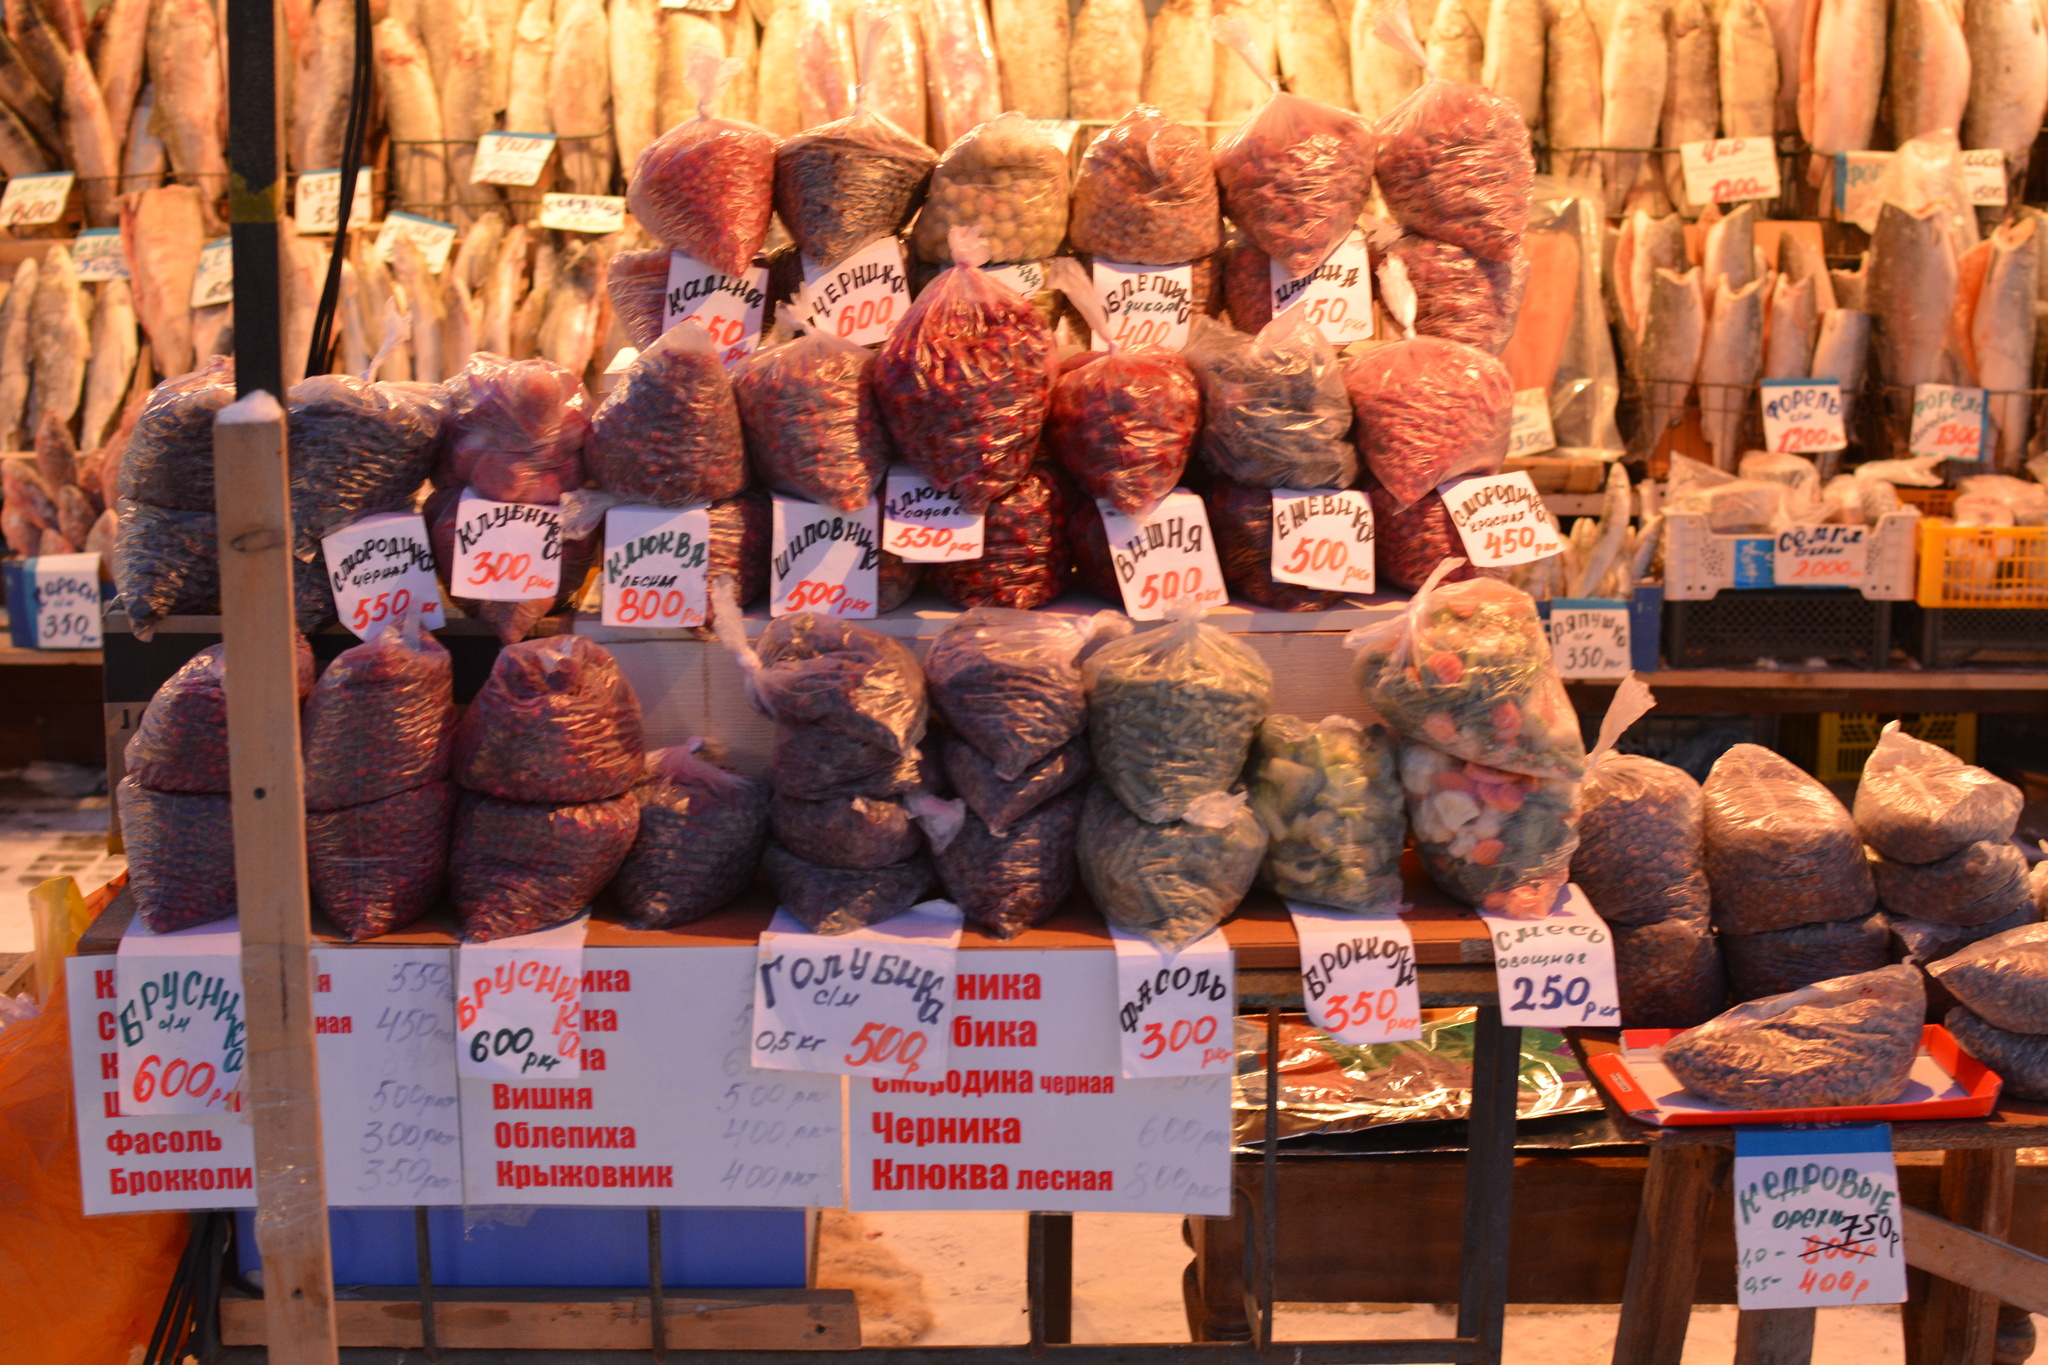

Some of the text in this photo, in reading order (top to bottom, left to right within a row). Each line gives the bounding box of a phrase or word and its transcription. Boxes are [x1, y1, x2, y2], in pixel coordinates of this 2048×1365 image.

[837, 296, 893, 338] 600
[890, 527, 954, 549] 550
[1115, 517, 1203, 585] ВИШНЯ
[1281, 537, 1349, 575] 500
[1483, 526, 1535, 560] 450
[466, 551, 532, 586] 300
[616, 588, 686, 624] 800
[784, 580, 847, 612] 500
[1138, 567, 1203, 609] 500
[42, 613, 88, 639] 350
[352, 588, 411, 630] 550
[1564, 646, 1603, 670] 350
[386, 961, 450, 993] 550
[1510, 974, 1591, 1011] 250
[375, 1006, 439, 1043] 450
[1322, 989, 1398, 1033] 350
[469, 1026, 534, 1063] 600
[755, 1030, 796, 1054] 0,5
[843, 1021, 929, 1067] 500
[1138, 1015, 1218, 1060] 300
[132, 1053, 216, 1104] 600
[368, 1079, 427, 1114] 500
[1040, 1075, 1115, 1096] черная
[493, 1083, 594, 1110] Вишня
[716, 1081, 787, 1114] 500
[107, 1129, 223, 1156] Фасоль
[360, 1120, 422, 1154] 300
[494, 1121, 637, 1149] Облепиха
[722, 1117, 786, 1149] 400
[872, 1112, 1021, 1147] Черника
[1137, 1116, 1200, 1149] 600
[110, 1166, 253, 1196] Брокколи
[356, 1157, 430, 1192] 350
[496, 1160, 674, 1190] Крыжовник
[720, 1158, 779, 1192] 400
[872, 1158, 1009, 1191] Клюква
[1016, 1169, 1114, 1191] лесная
[1122, 1161, 1192, 1200] 800
